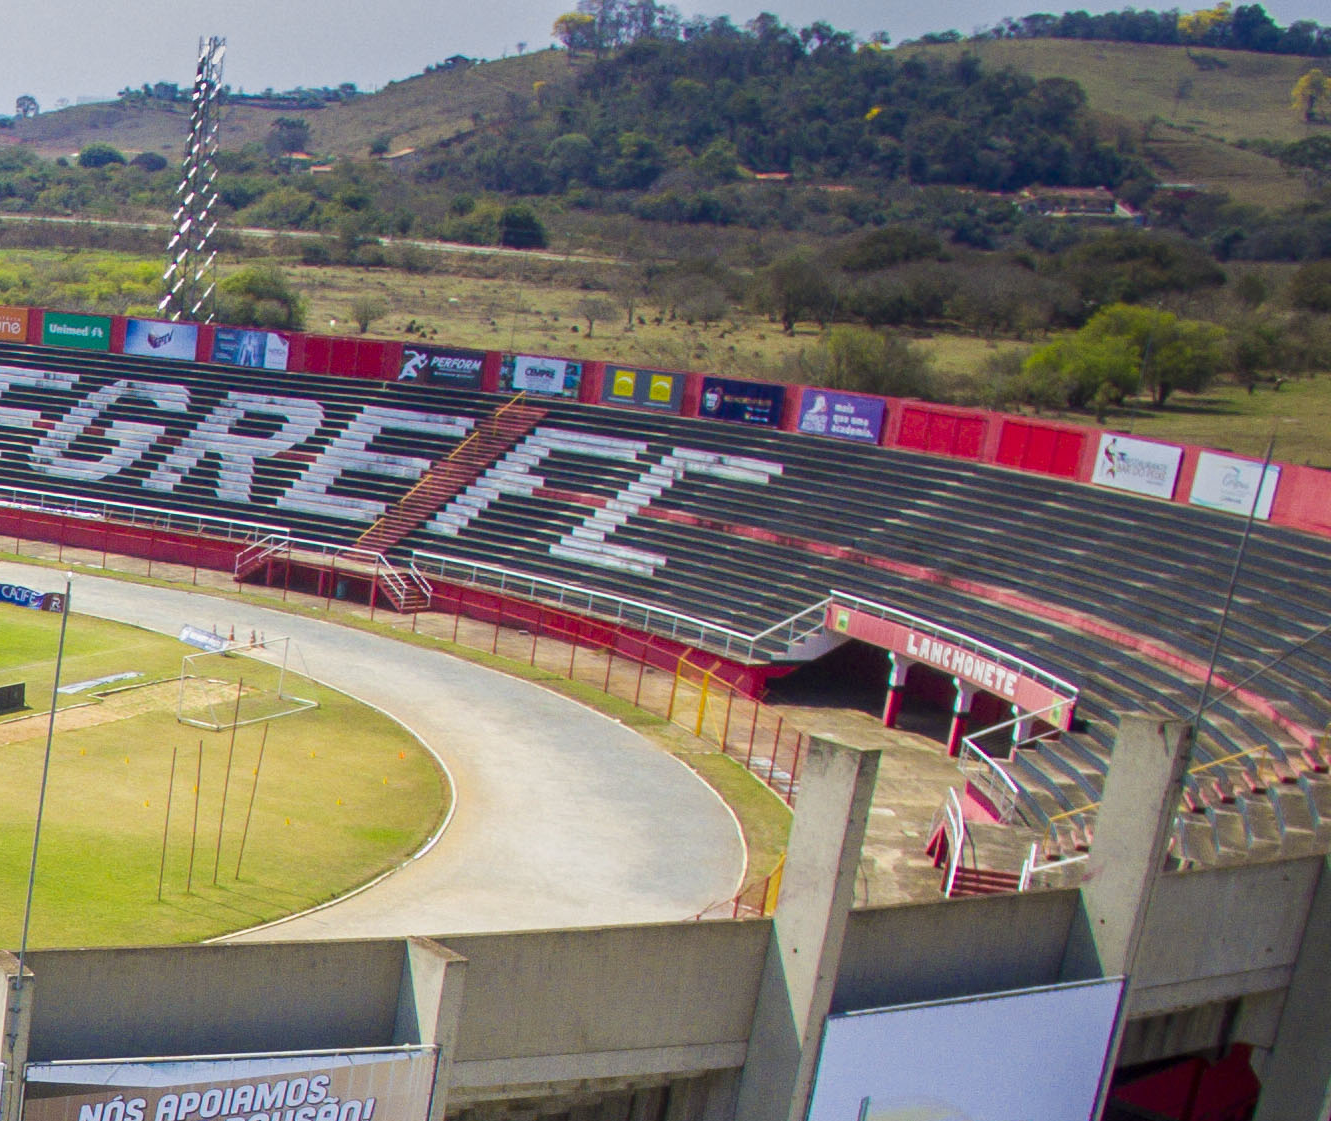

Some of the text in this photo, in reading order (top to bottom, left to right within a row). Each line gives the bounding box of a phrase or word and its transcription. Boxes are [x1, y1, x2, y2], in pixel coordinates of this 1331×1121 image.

[49, 323, 89, 337] Unimed
[430, 356, 482, 371] PERFORM
[906, 633, 1018, 697] LANCHONETE
